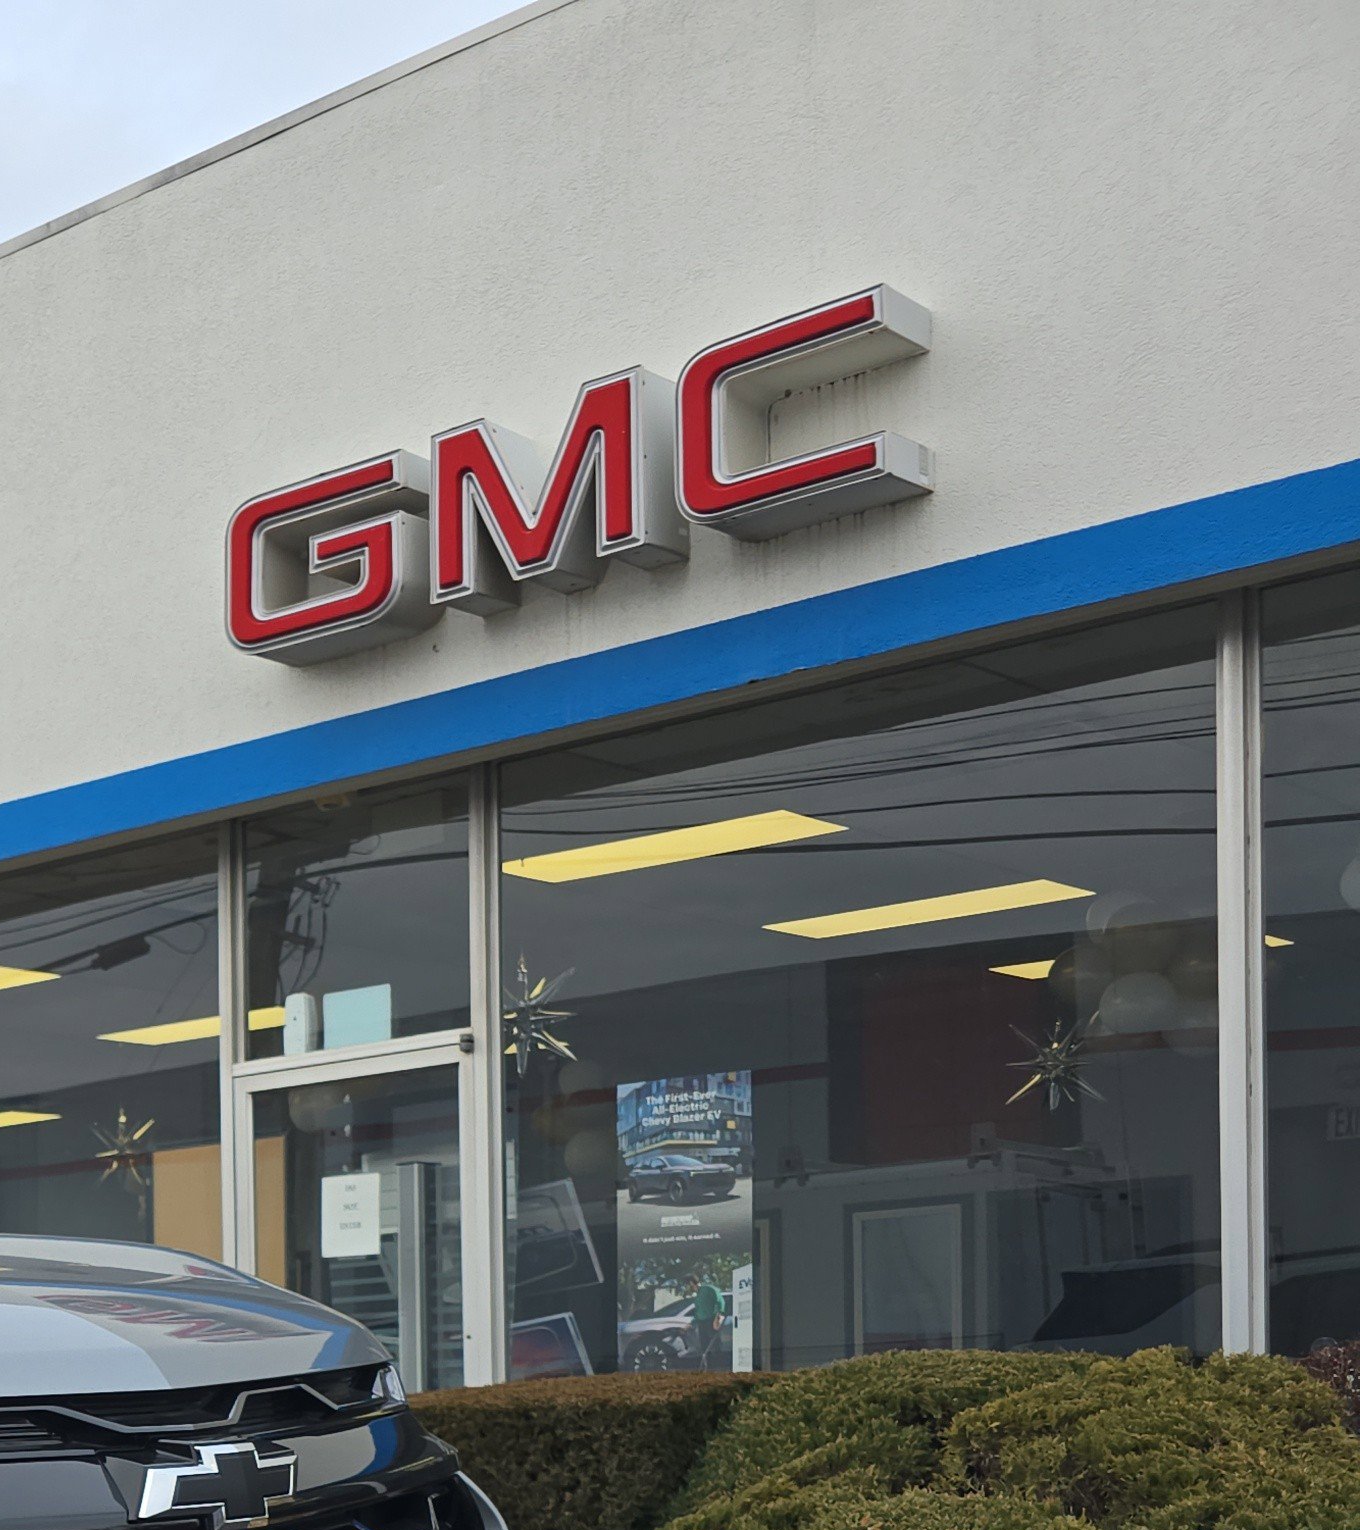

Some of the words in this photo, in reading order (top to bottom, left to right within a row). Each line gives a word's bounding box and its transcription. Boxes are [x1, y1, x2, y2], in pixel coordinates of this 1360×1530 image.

[224, 282, 932, 662] GMC
[652, 1101, 710, 1115] All-Electric
[641, 1116, 671, 1127] Chevy
[672, 1113, 705, 1123] Blazer
[707, 1109, 722, 1121] EV
